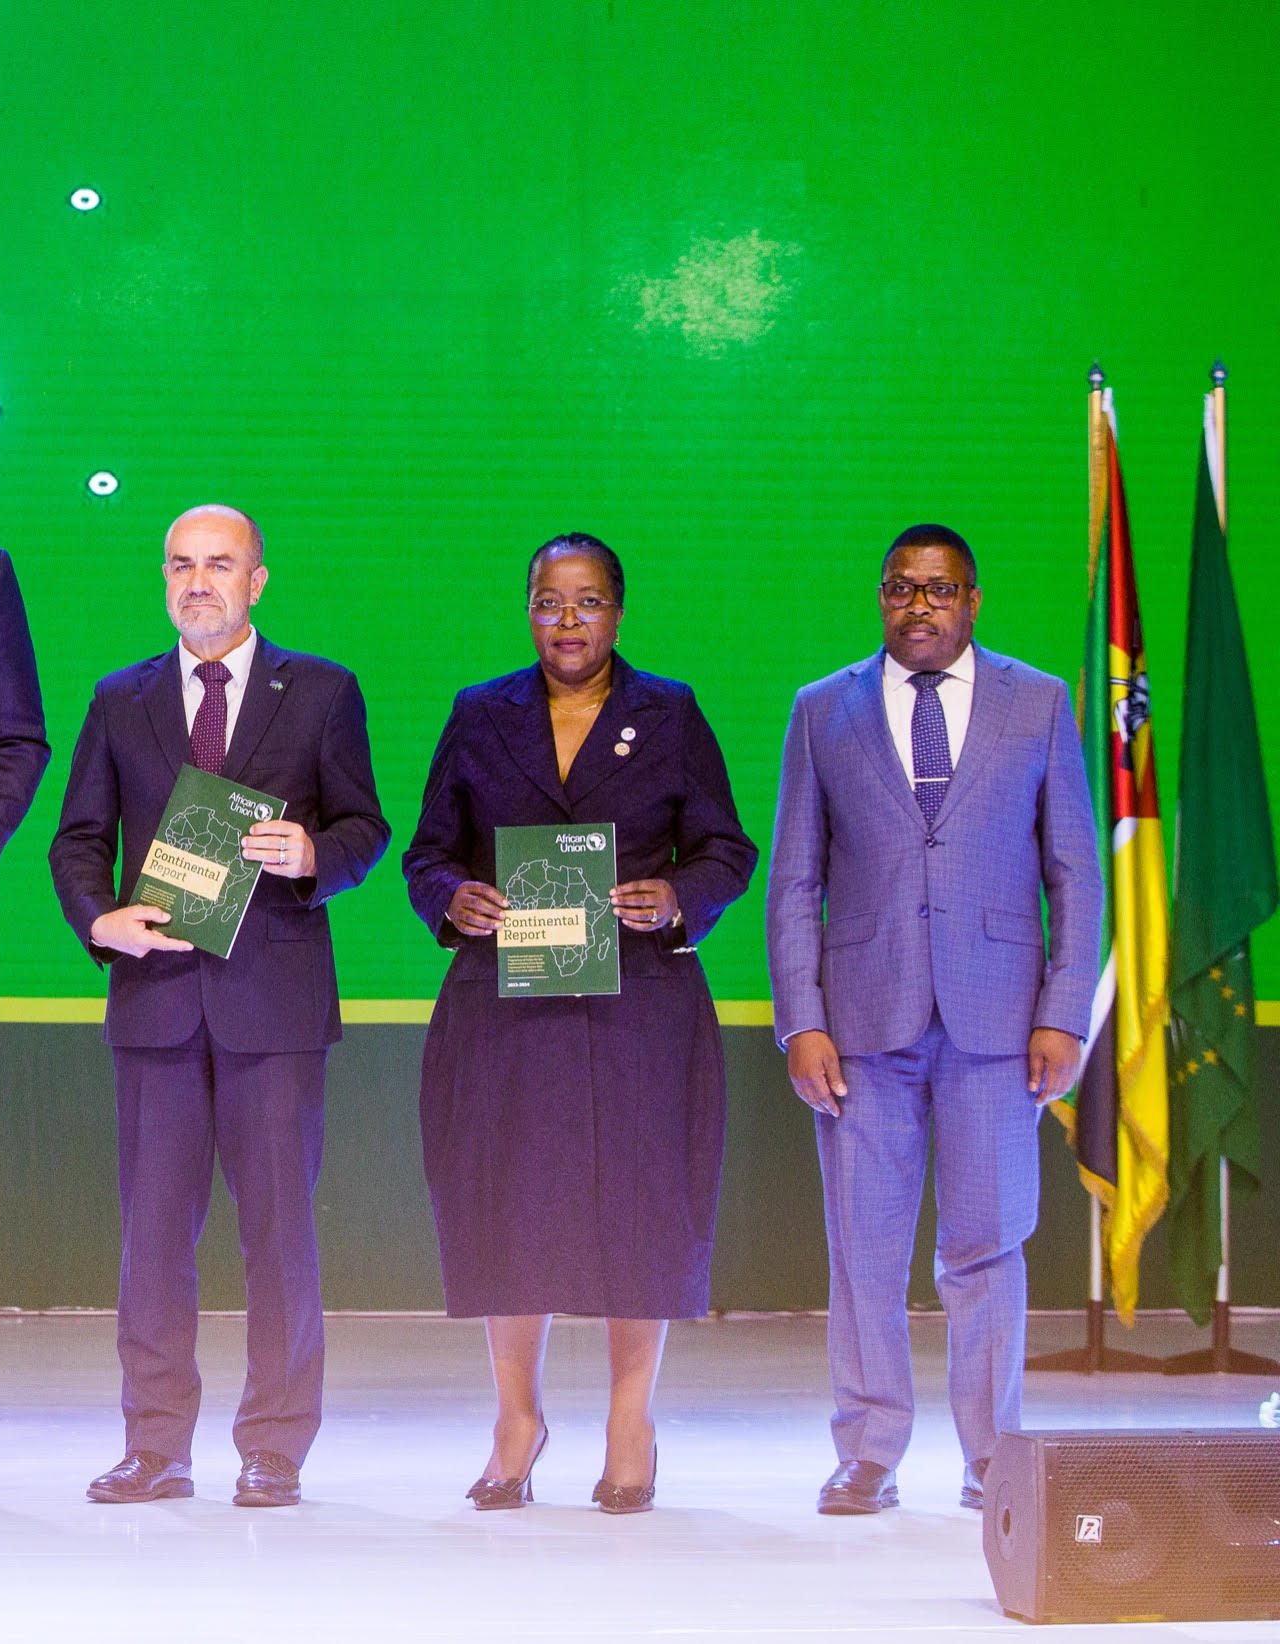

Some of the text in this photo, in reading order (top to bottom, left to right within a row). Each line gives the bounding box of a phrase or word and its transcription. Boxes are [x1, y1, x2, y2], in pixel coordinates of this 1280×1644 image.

[229, 791, 257, 809] African
[230, 802, 254, 818] Union
[555, 833, 586, 844] African
[560, 843, 586, 852] Union
[148, 860, 187, 882] Report
[154, 847, 221, 882] Continental
[503, 915, 579, 928] Continental
[504, 929, 547, 943] Report
